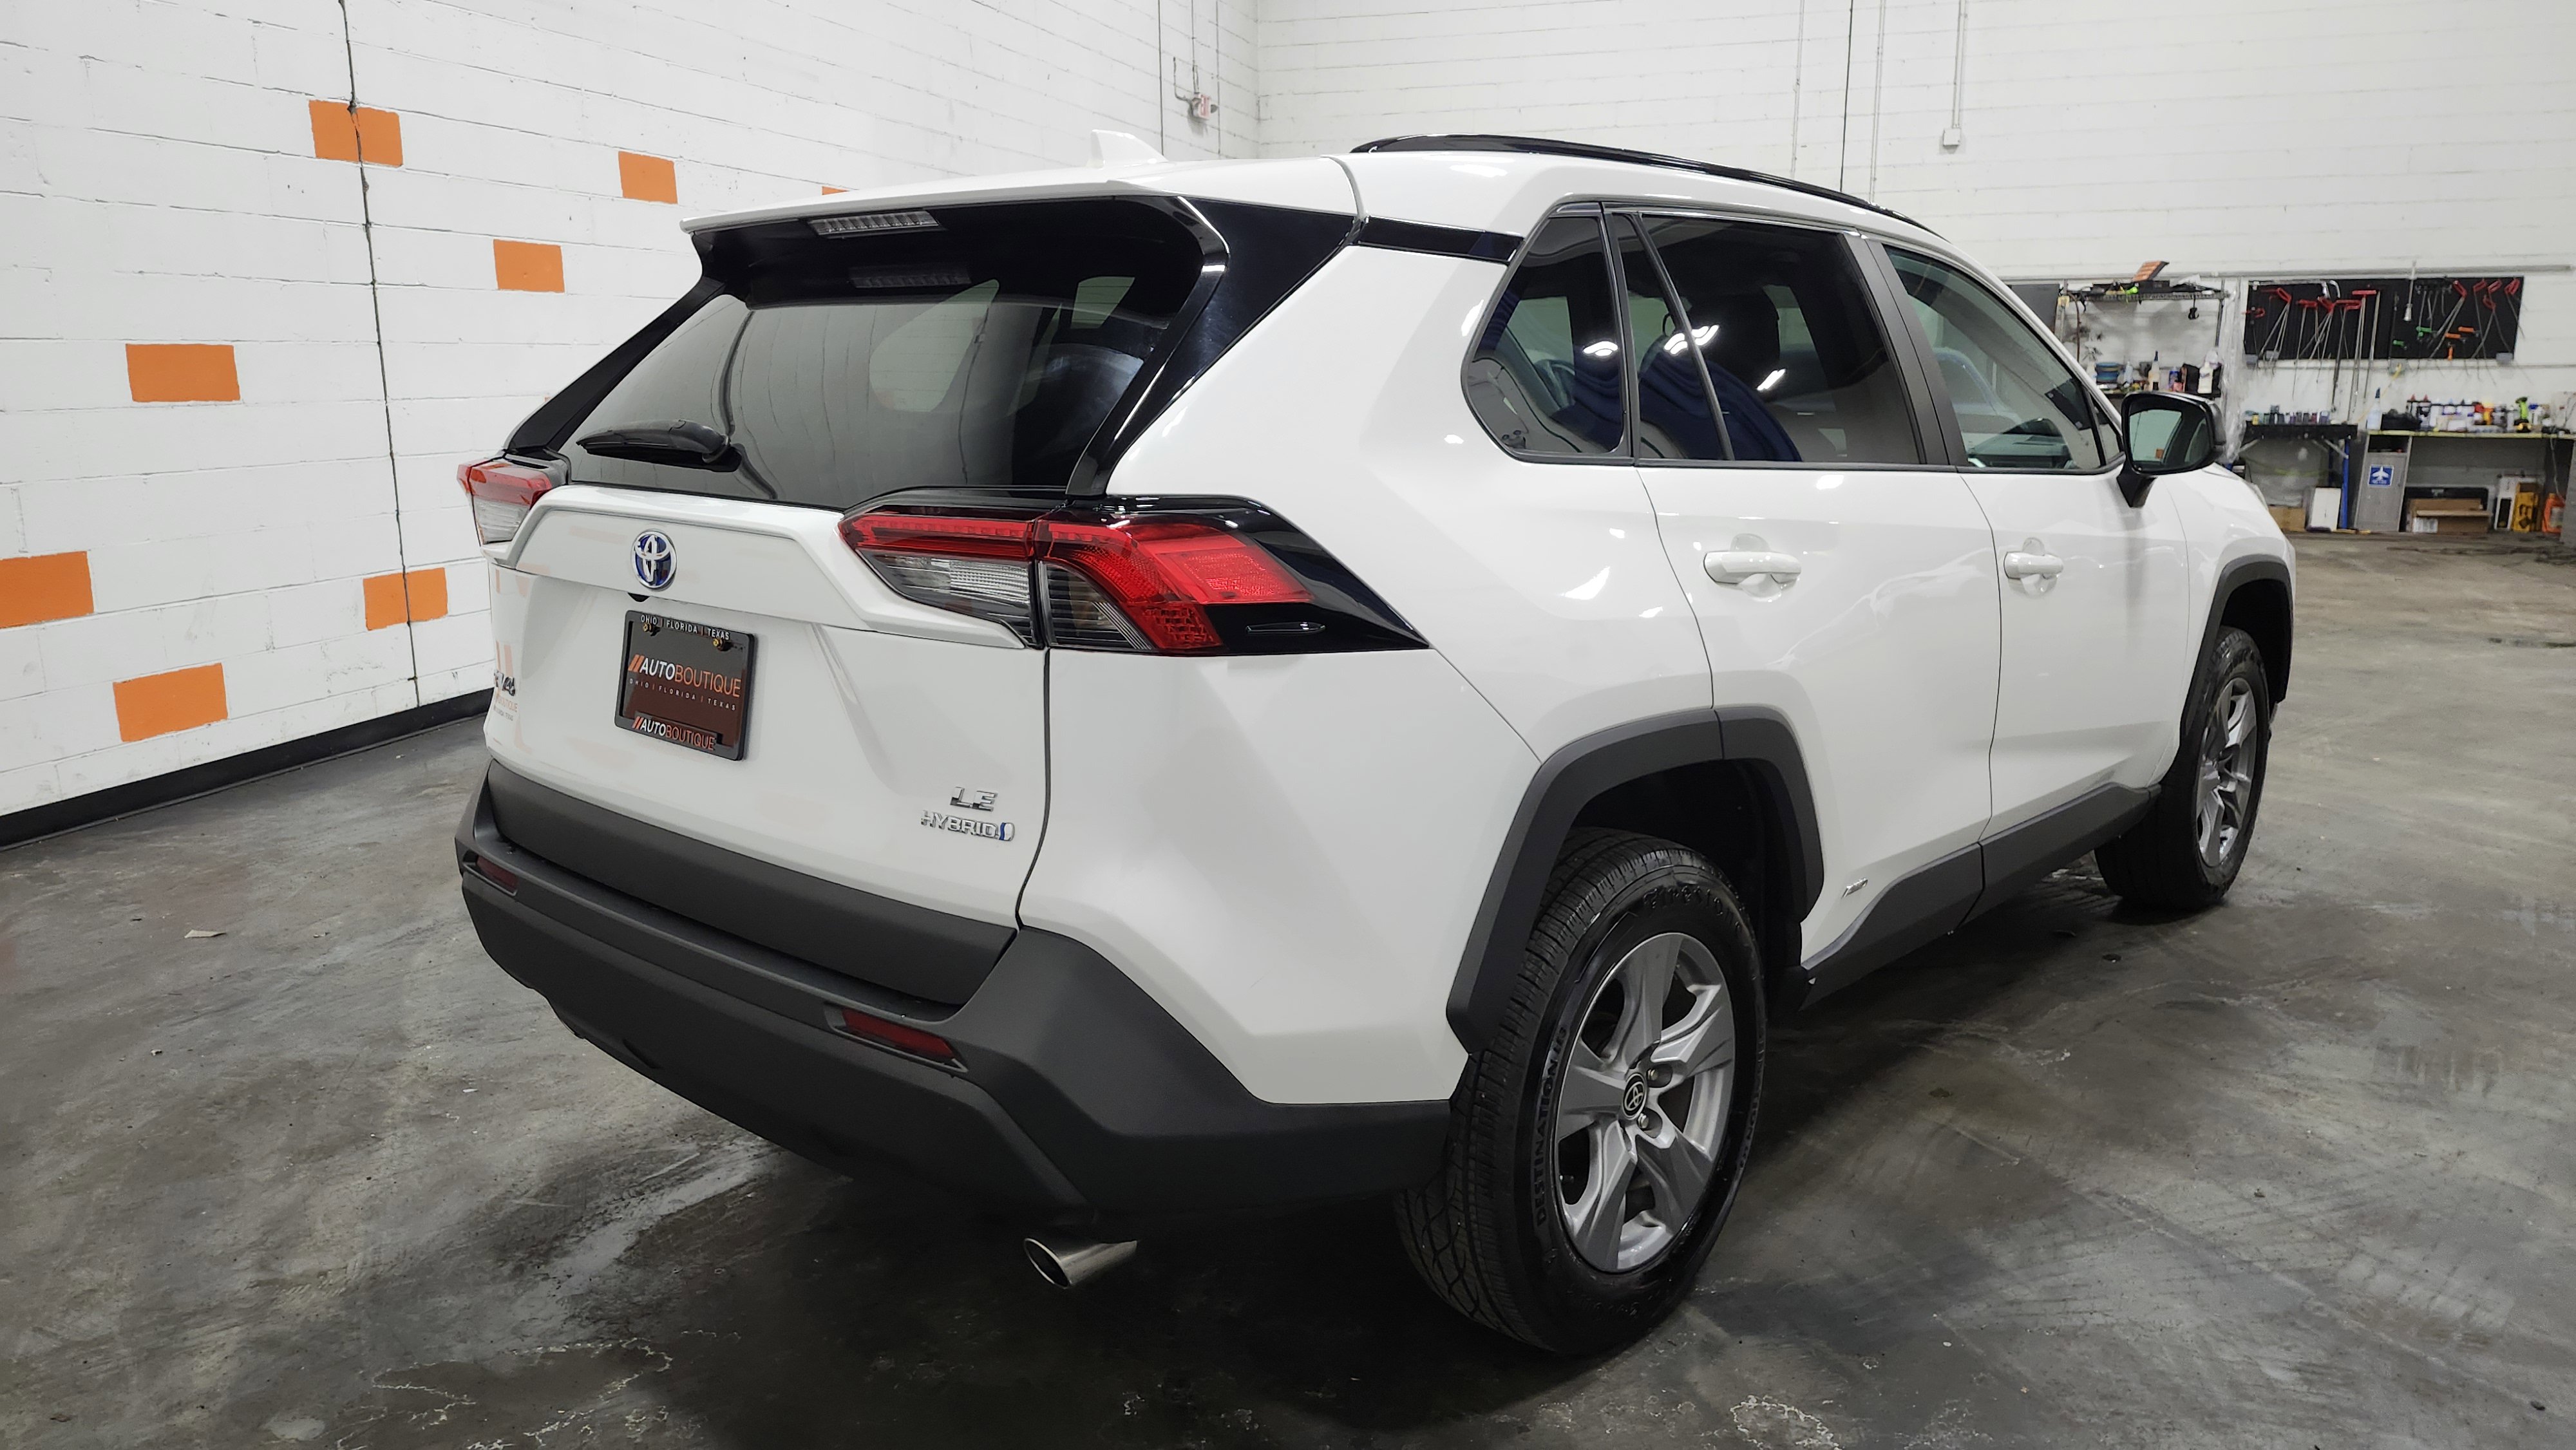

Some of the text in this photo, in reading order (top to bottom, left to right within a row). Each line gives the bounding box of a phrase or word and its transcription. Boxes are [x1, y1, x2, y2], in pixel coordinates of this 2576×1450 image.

[640, 614, 730, 641] OHIO FLORIDA TEXAS
[629, 678, 736, 711] OHIO FLORIDA TEXAS
[950, 786, 998, 812] LE
[920, 810, 998, 839] HYBRID
[1534, 1060, 1558, 1227] DESTINATION
